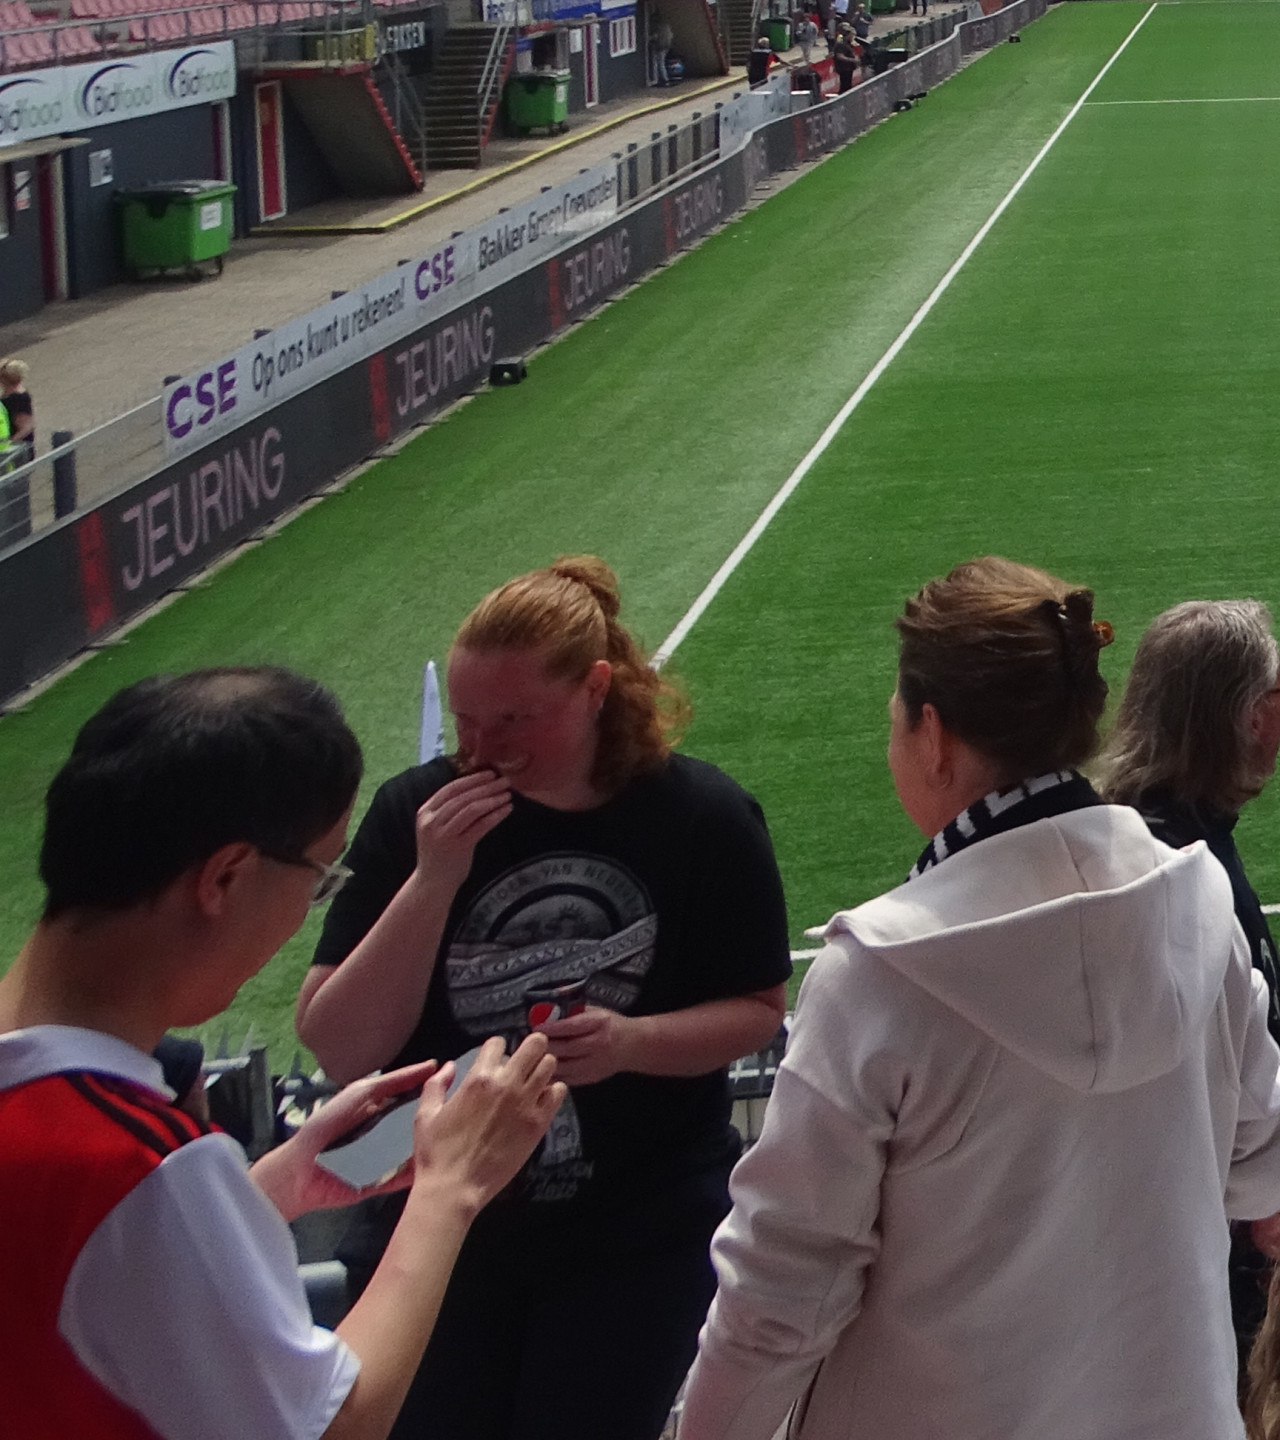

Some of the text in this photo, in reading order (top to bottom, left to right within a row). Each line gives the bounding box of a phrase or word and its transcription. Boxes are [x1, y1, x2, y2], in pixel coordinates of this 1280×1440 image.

[166, 359, 238, 438] CSE
[251, 343, 275, 397] Op
[278, 339, 304, 375] ons
[306, 317, 339, 359] kunt
[351, 277, 406, 335] rekenen!
[413, 245, 455, 301] CSE
[477, 224, 525, 272] Bakker
[562, 227, 631, 312] JEURING
[394, 305, 496, 417] JEURING
[121, 427, 286, 591] JEURING
